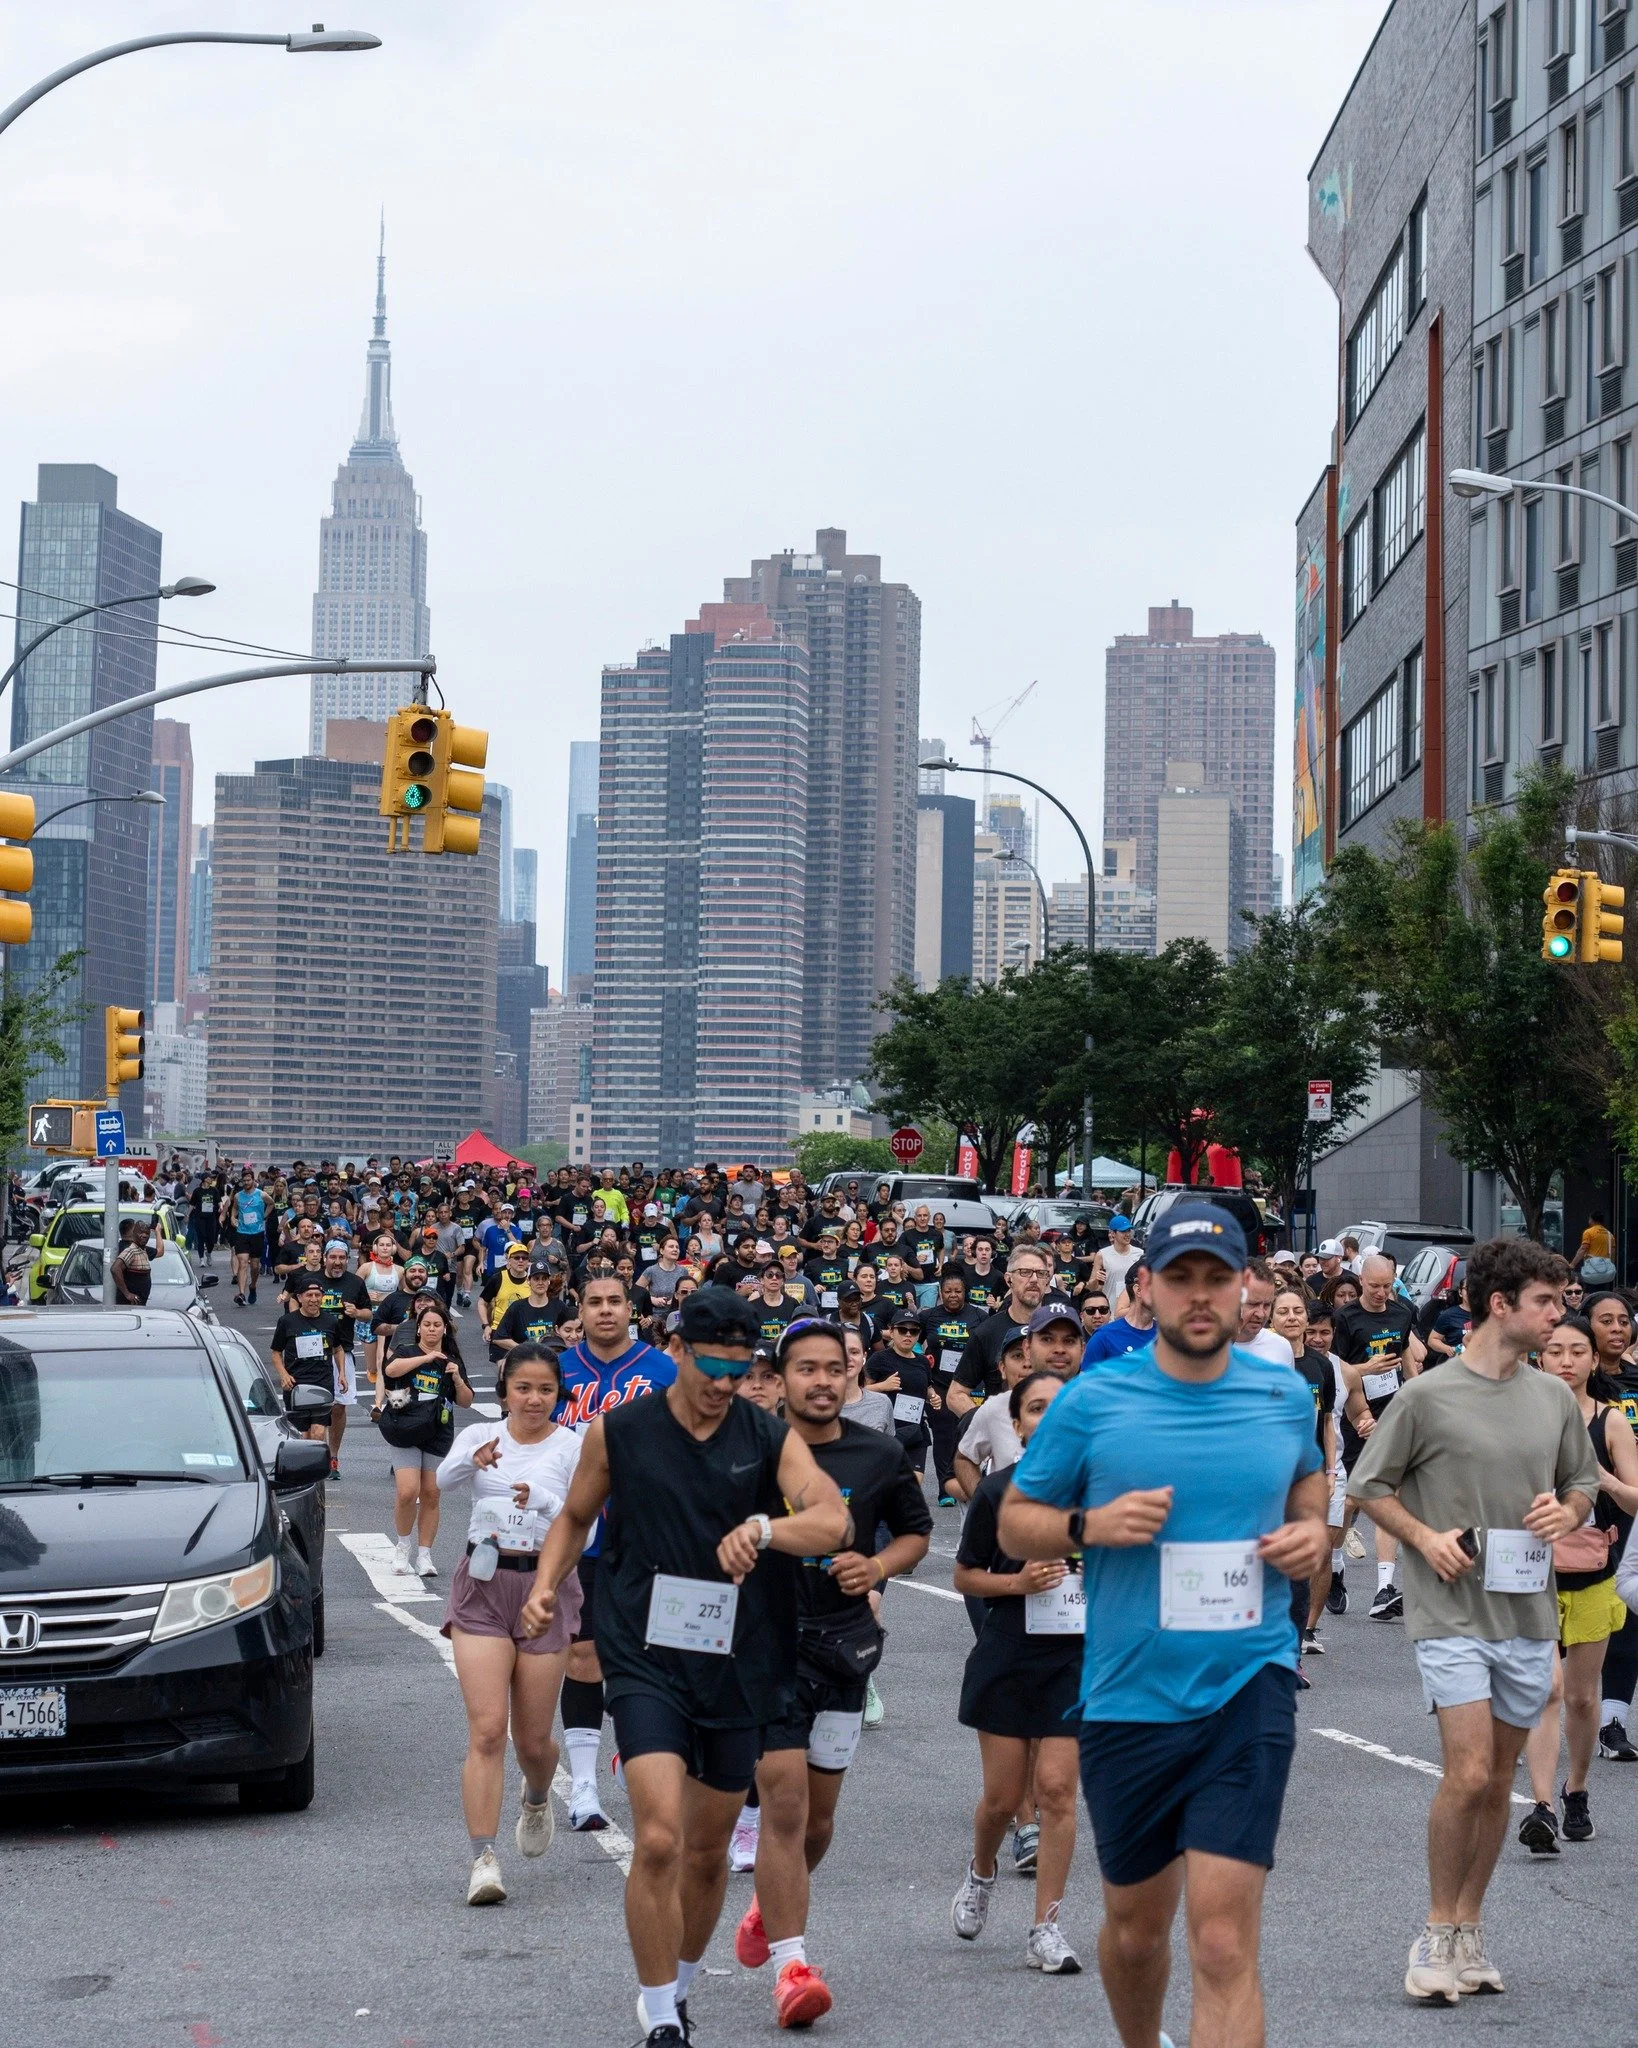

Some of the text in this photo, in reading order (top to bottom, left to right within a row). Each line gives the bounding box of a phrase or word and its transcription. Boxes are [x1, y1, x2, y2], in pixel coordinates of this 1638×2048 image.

[892, 1138, 922, 1151] STOP
[508, 1514, 524, 1526] 112
[1525, 1550, 1546, 1563] 1484
[1223, 1569, 1249, 1588] 166
[1515, 1568, 1533, 1576] Kevin
[1063, 1593, 1087, 1606] 1458
[698, 1603, 722, 1619] 273
[17, 1701, 56, 1726] 7566
